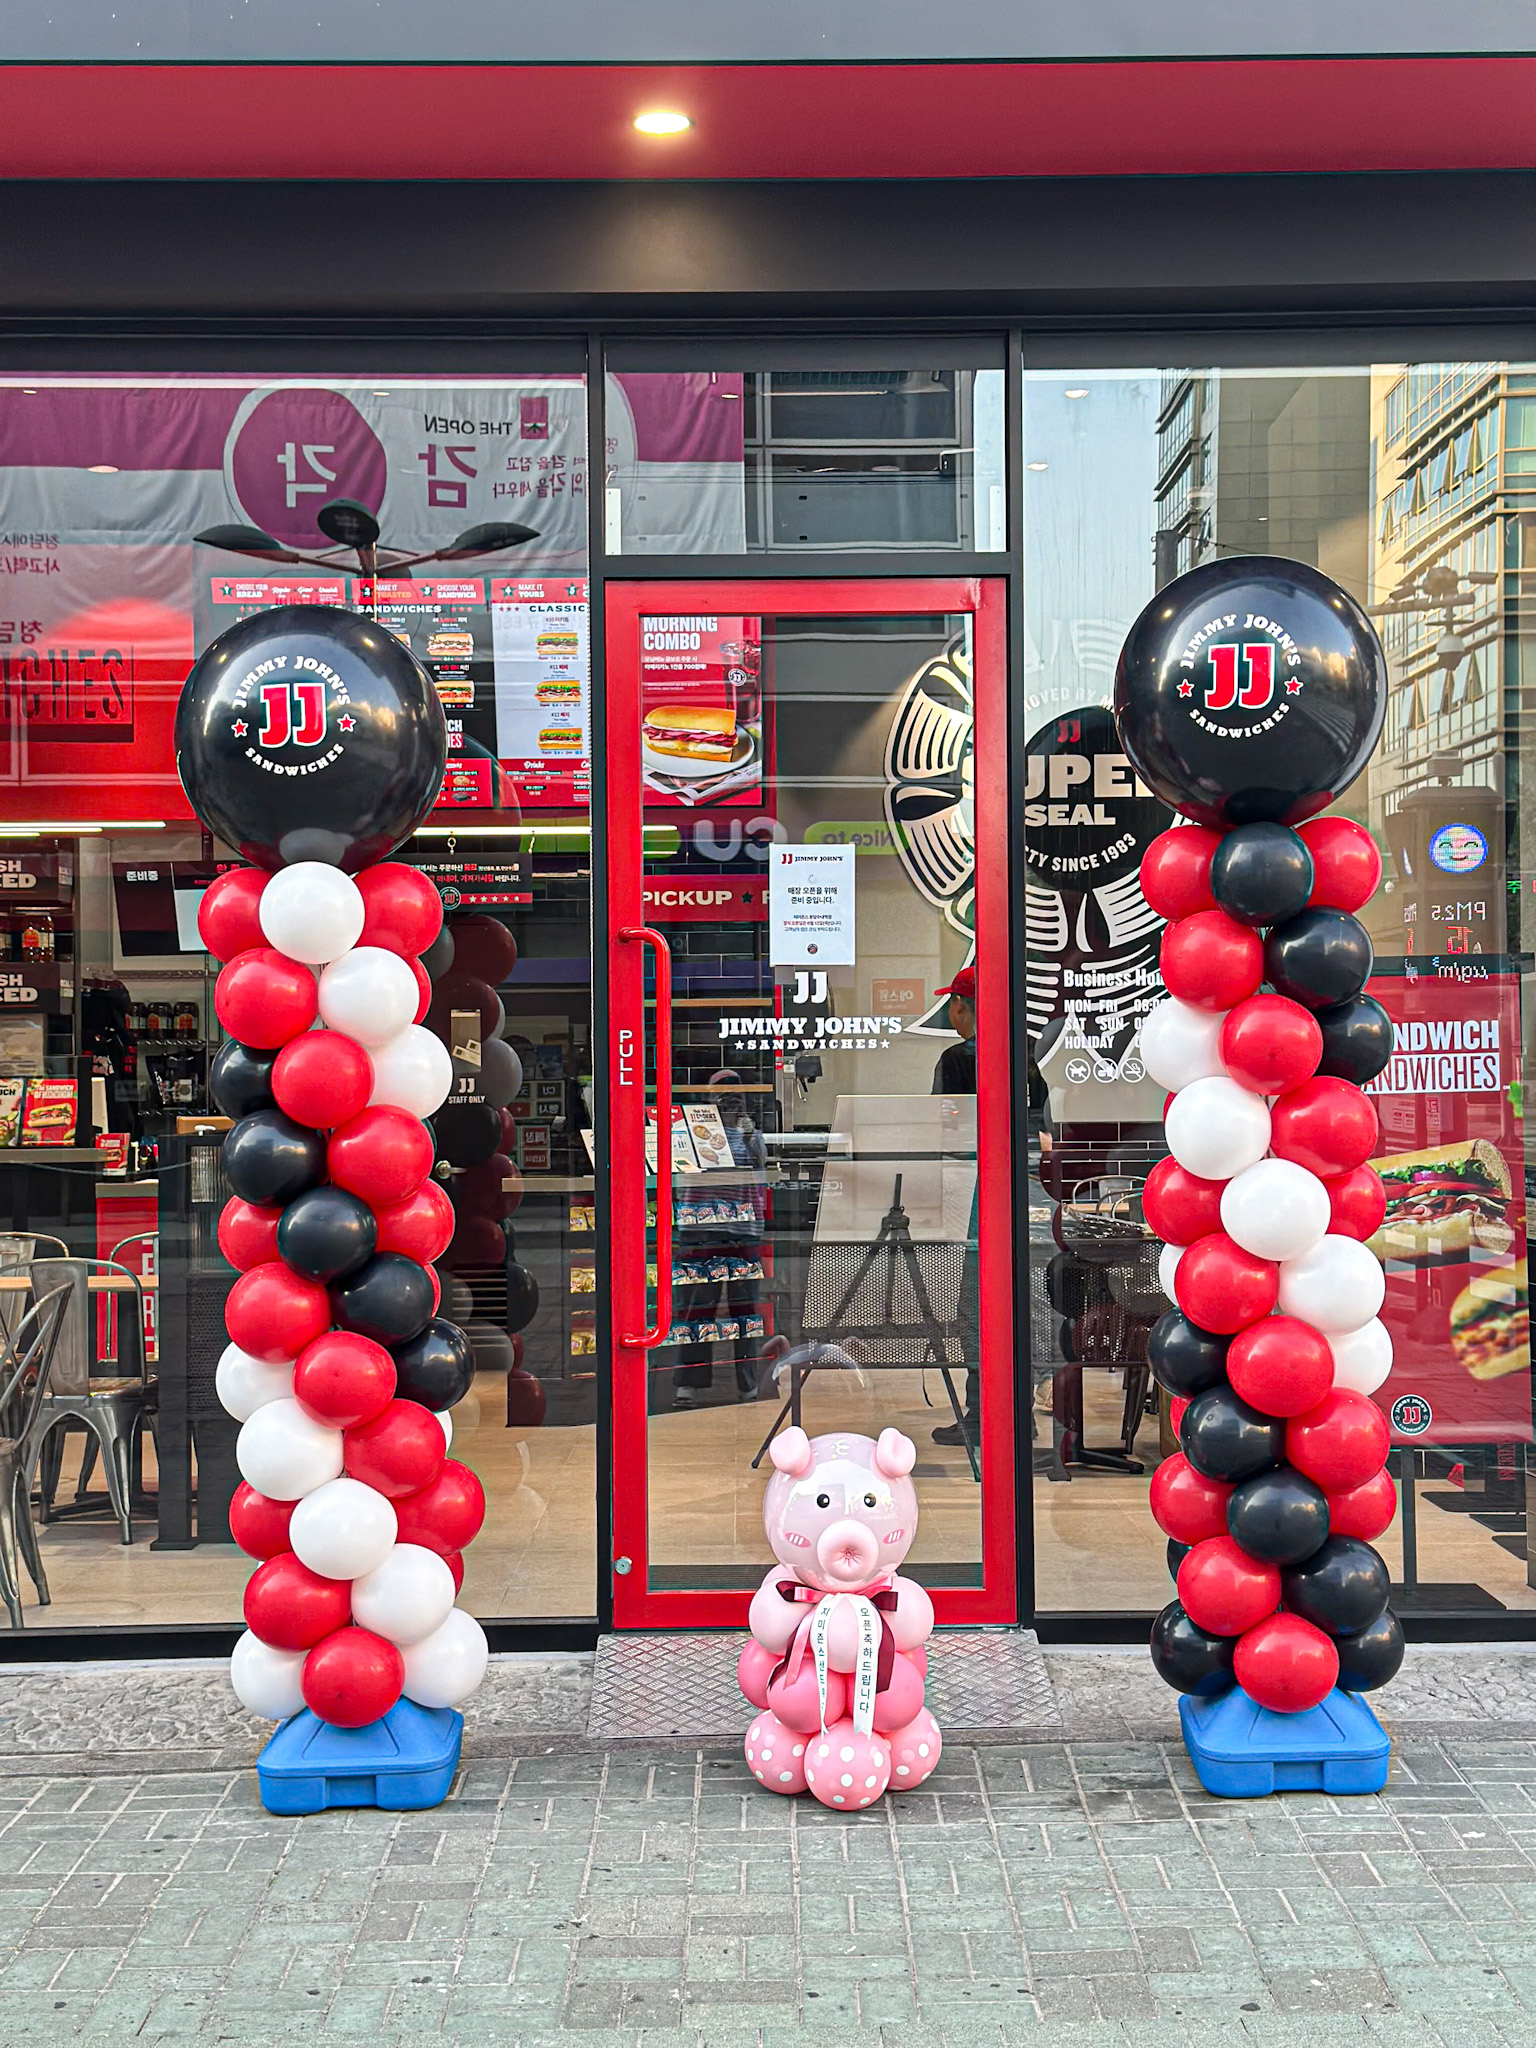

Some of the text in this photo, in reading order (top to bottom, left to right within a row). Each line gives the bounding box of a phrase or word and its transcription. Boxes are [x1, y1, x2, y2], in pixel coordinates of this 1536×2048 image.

[437, 591, 476, 599] SANDWICH
[518, 590, 545, 598] YOURS
[356, 605, 442, 613] SANDWICHES
[643, 616, 718, 632] MORNING
[643, 633, 701, 651] COMBO
[1179, 613, 1301, 669] JIMMY JOHN'S
[232, 656, 351, 710] JIMMY JOHN'S
[1204, 642, 1275, 710] JJ
[258, 683, 327, 748] JJ
[1189, 702, 1290, 739] SANDWICHES
[1057, 719, 1081, 743] JJ
[245, 743, 345, 776] SANDWICHES
[1024, 803, 1116, 827] SEAL
[1051, 853, 1100, 873] SINCE
[1100, 832, 1137, 864] 1983
[0, 873, 37, 889] ED
[126, 870, 159, 882] 준비중
[643, 890, 733, 906] PICKUP
[791, 896, 805, 904] 준비
[824, 887, 838, 895] 위해
[1063, 968, 1132, 987] Business
[793, 971, 828, 1004] JJ
[1064, 999, 1092, 1013] MON
[1099, 999, 1118, 1013] FRI
[718, 1016, 903, 1039] JIMMY JOHN'S
[1065, 1017, 1087, 1031] SAT
[1099, 1017, 1125, 1031] SUN
[747, 1039, 878, 1050] SANDWICHES
[1065, 1036, 1115, 1049] HOLIDAY
[619, 1029, 634, 1086] PULL
[458, 1078, 475, 1094] JJ
[448, 1095, 486, 1104] STAFF ONLY
[1402, 1406, 1421, 1425] JJ
[860, 1608, 873, 1713] 오픈축하드립니다
